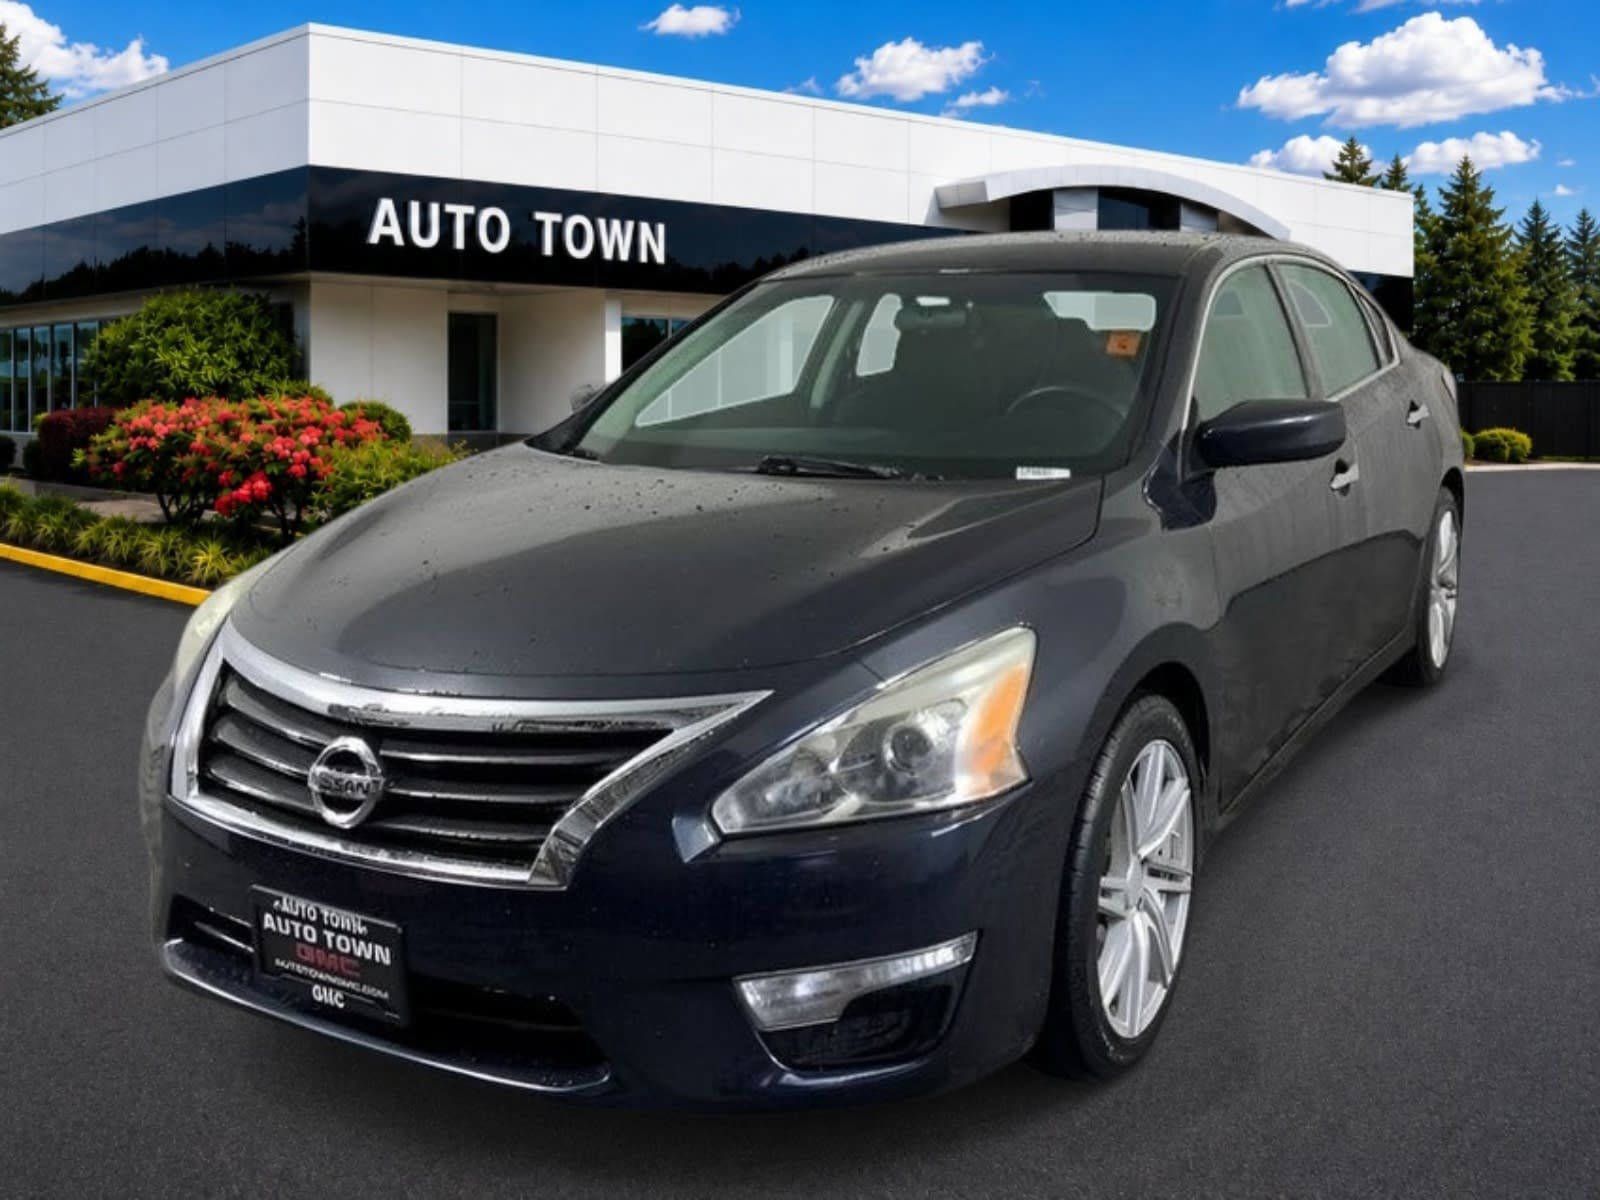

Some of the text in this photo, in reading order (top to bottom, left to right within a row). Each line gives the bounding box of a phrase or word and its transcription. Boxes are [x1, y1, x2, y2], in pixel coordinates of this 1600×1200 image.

[366, 197, 667, 265] AUTO TOWN
[263, 912, 392, 966] AUTO TOWN
[295, 942, 361, 978] GMC
[312, 984, 346, 1009] GMC
